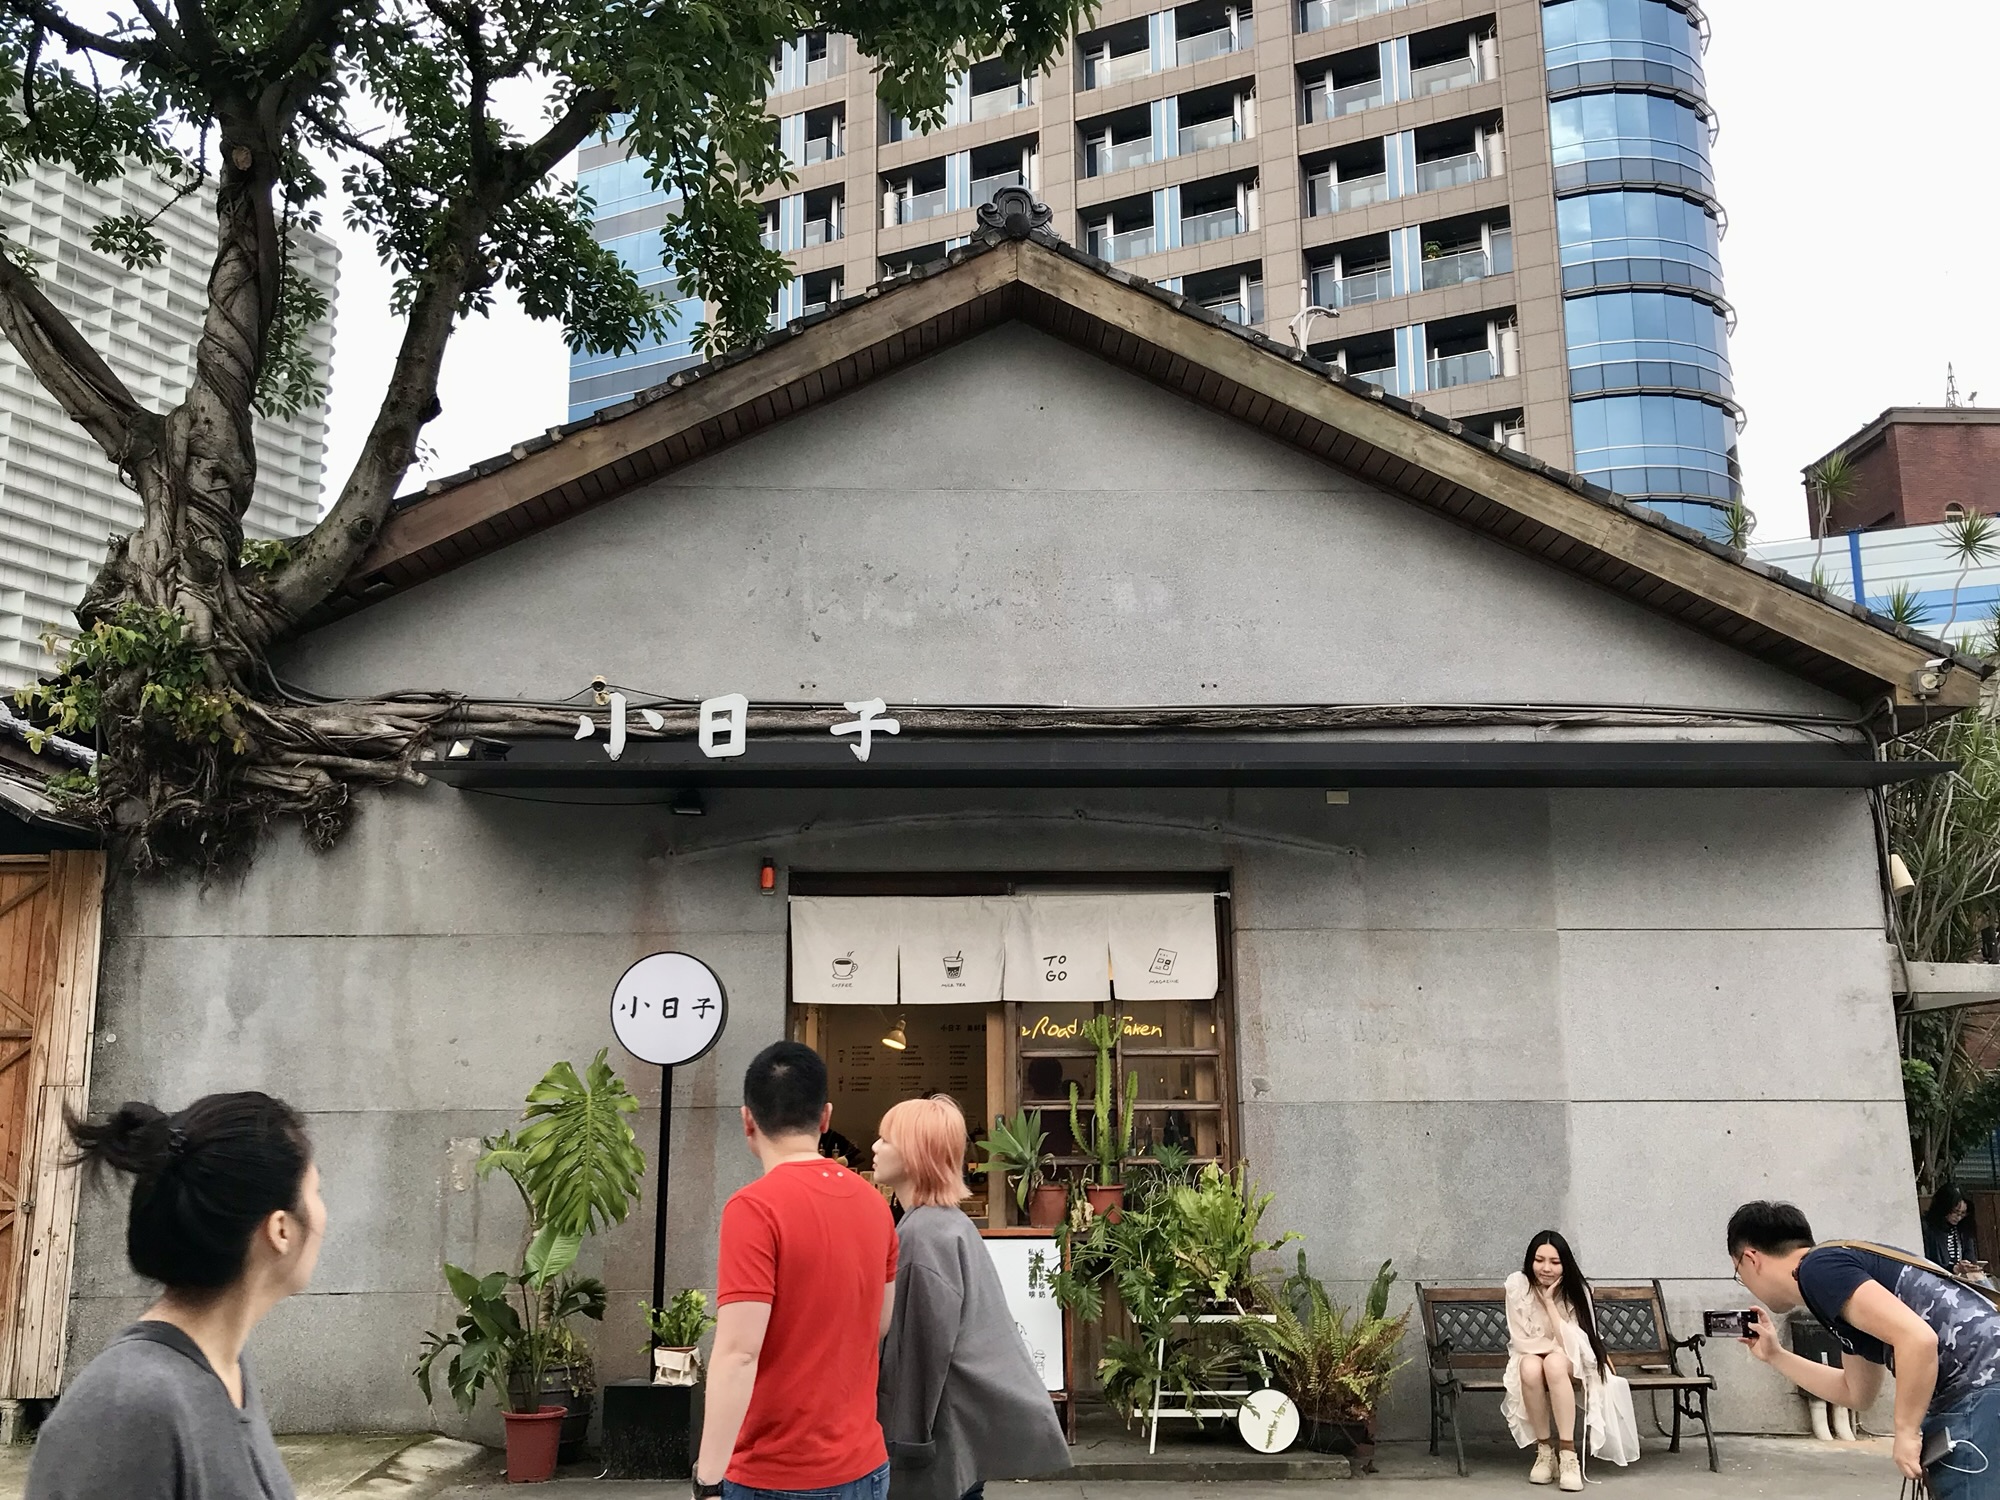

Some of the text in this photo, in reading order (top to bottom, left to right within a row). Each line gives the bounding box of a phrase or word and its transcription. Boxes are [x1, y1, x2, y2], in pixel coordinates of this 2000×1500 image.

[574, 692, 901, 762] 小日子
[1043, 955, 1067, 966] TO
[1045, 970, 1068, 982] GO
[620, 995, 715, 1020] 小日子
[1031, 1016, 1077, 1039] Road
